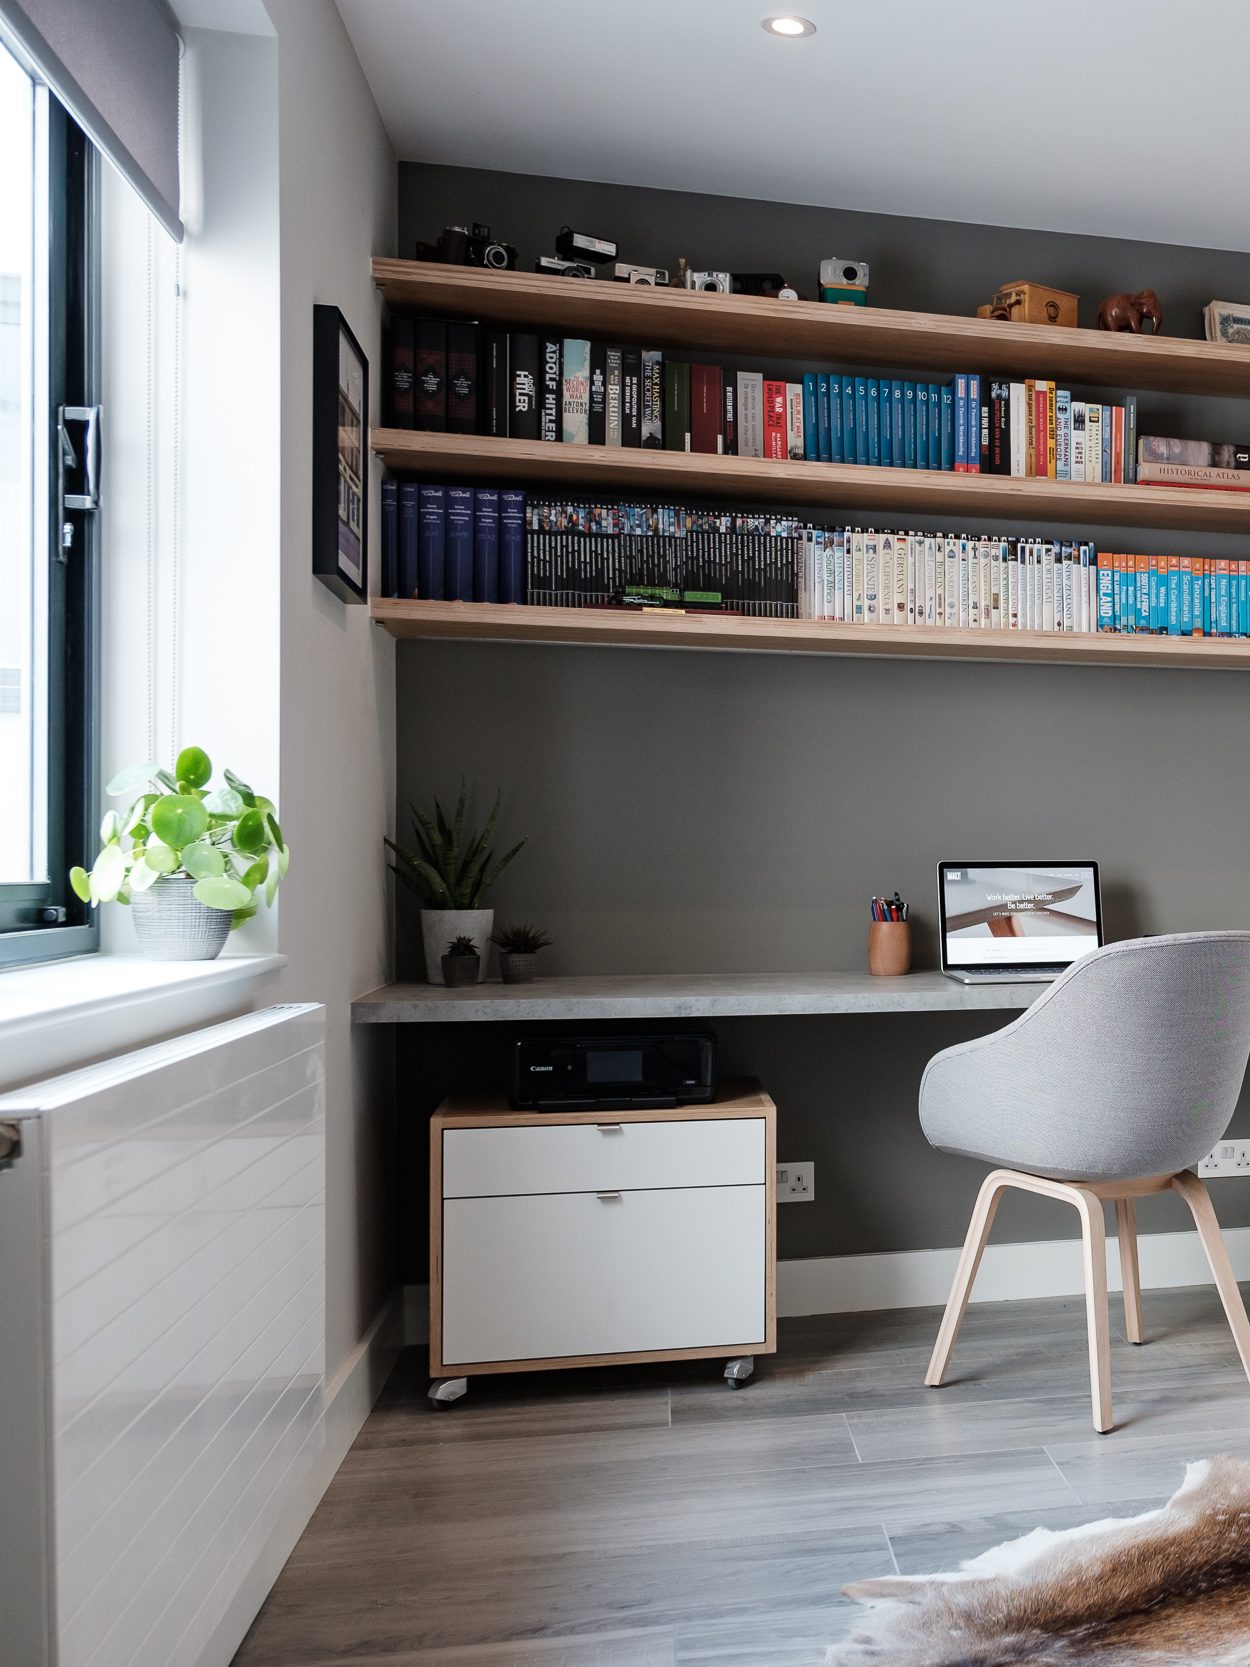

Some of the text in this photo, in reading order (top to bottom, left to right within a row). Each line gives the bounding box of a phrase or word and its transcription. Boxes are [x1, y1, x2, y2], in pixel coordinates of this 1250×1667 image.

[545, 342, 556, 440] ADOLF HITLER
[566, 385, 587, 393] WORLD
[808, 382, 813, 391] 1
[821, 383, 827, 392] 2
[833, 384, 839, 393] 3
[846, 386, 852, 394] 4
[859, 386, 865, 395] 5
[516, 371, 528, 412] HITLER
[871, 388, 877, 396] 6
[883, 388, 889, 397] 7
[894, 390, 901, 398] 8
[907, 391, 913, 399] 9
[918, 392, 927, 400] 10
[931, 394, 938, 402] 11
[944, 395, 952, 404] 12
[608, 385, 620, 428] BERLIJN
[652, 386, 660, 423] HASTINGS
[775, 397, 783, 412] WAR
[1159, 467, 1212, 478] HISTORICAL
[866, 556, 876, 592] SPANJE
[896, 548, 906, 596] GERMANY
[1100, 571, 1112, 617] ENGLAND
[1218, 597, 1227, 625] England
